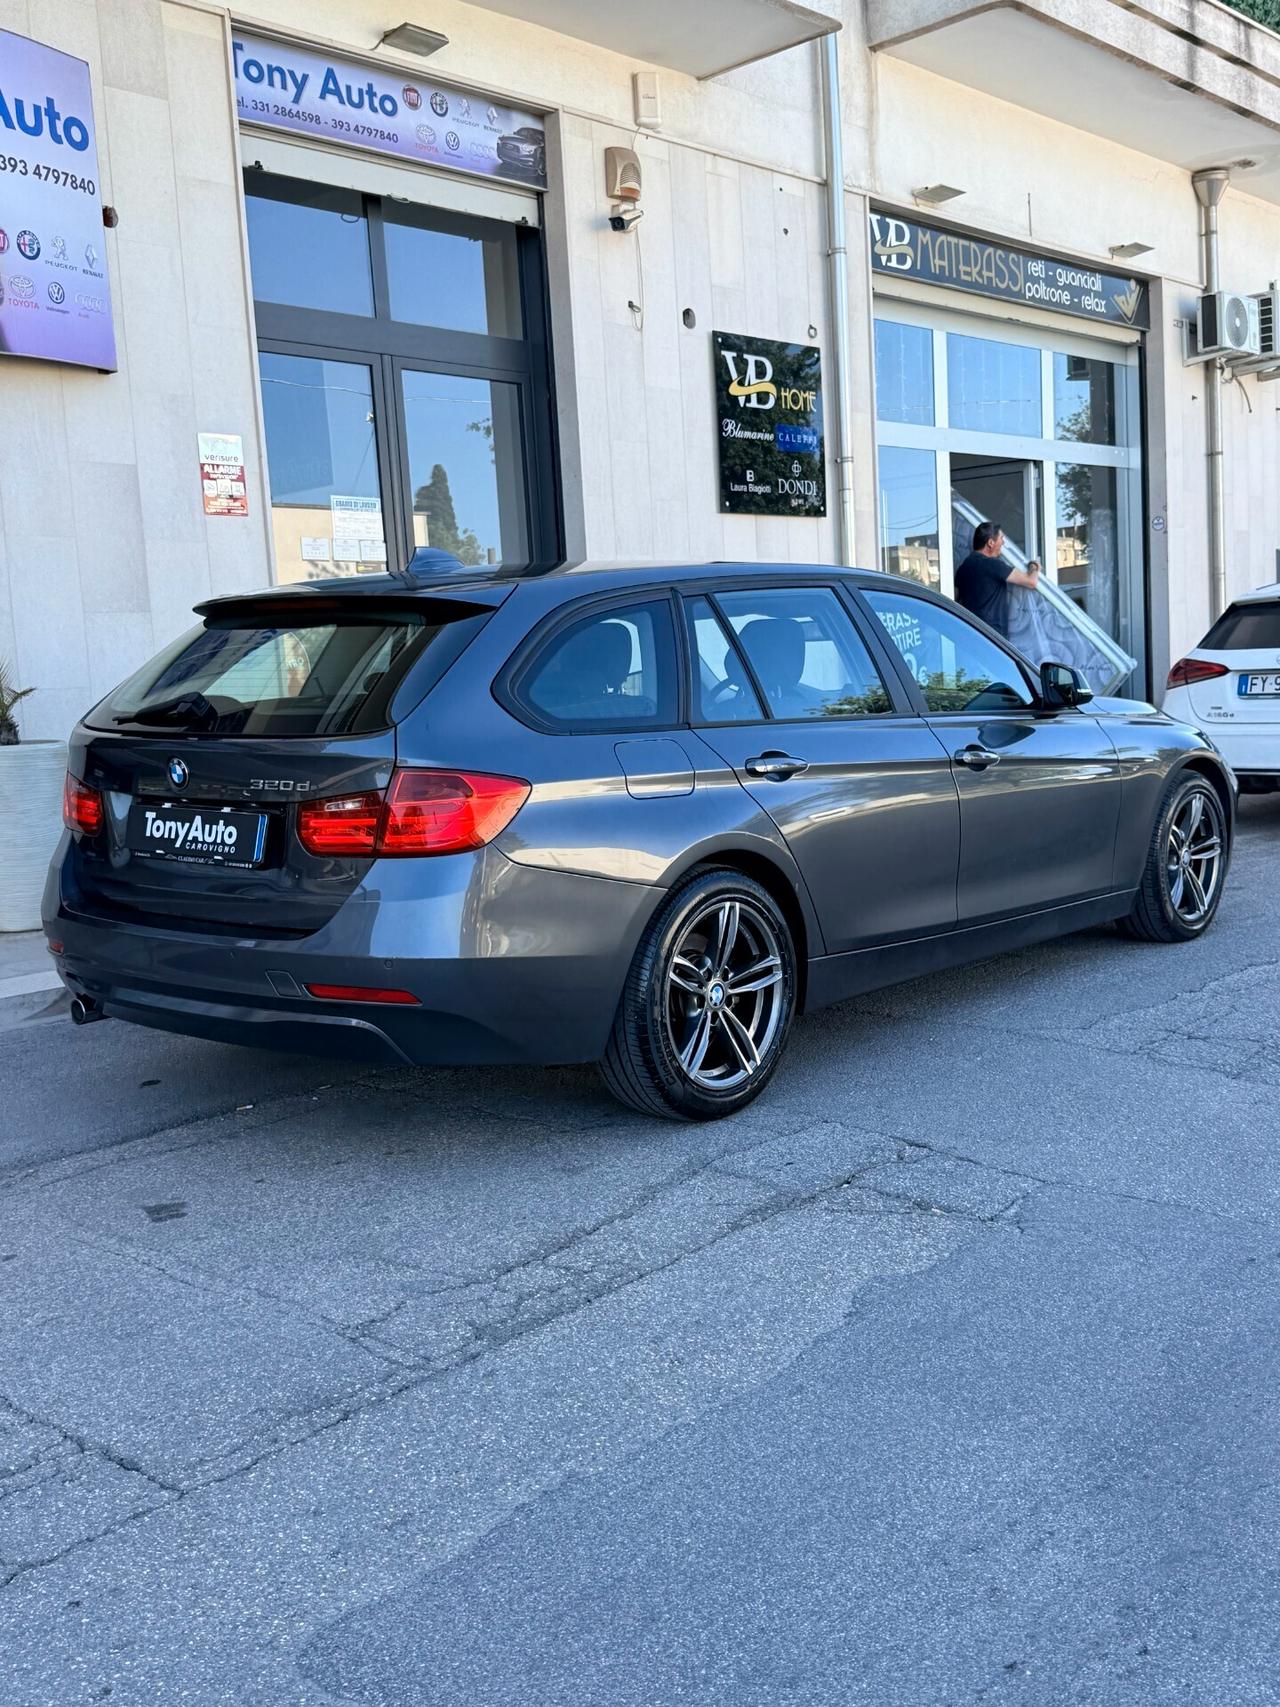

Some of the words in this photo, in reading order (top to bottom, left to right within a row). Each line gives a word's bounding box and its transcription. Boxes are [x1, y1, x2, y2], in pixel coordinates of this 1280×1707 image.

[319, 67, 398, 118] Auto
[236, 96, 249, 109] el.
[251, 99, 270, 114] 331
[273, 104, 321, 125] 2864598
[331, 118, 351, 133] 393
[353, 124, 398, 144] 4797840
[0, 154, 29, 176] 393
[32, 163, 95, 195] 4797840
[45, 259, 79, 272] PEUGEOT
[917, 228, 1025, 294] MATERASSI
[1027, 260, 1045, 278] reti
[1056, 267, 1102, 291] guanciali
[8, 297, 40, 310] TOYOTA
[1025, 281, 1071, 305] poltrone
[1081, 294, 1107, 313] relax
[721, 350, 777, 410] VB
[780, 387, 817, 412] HOME
[722, 418, 774, 442] Blumarine
[204, 453, 239, 463] verisure
[203, 464, 242, 476] ALLARME
[746, 469, 755, 482] B
[730, 482, 747, 493] Laura
[748, 482, 772, 494] Biagiotti
[778, 478, 817, 496] DONDI
[1249, 676, 1269, 692] FY
[185, 841, 236, 854] CAROVIGNO
